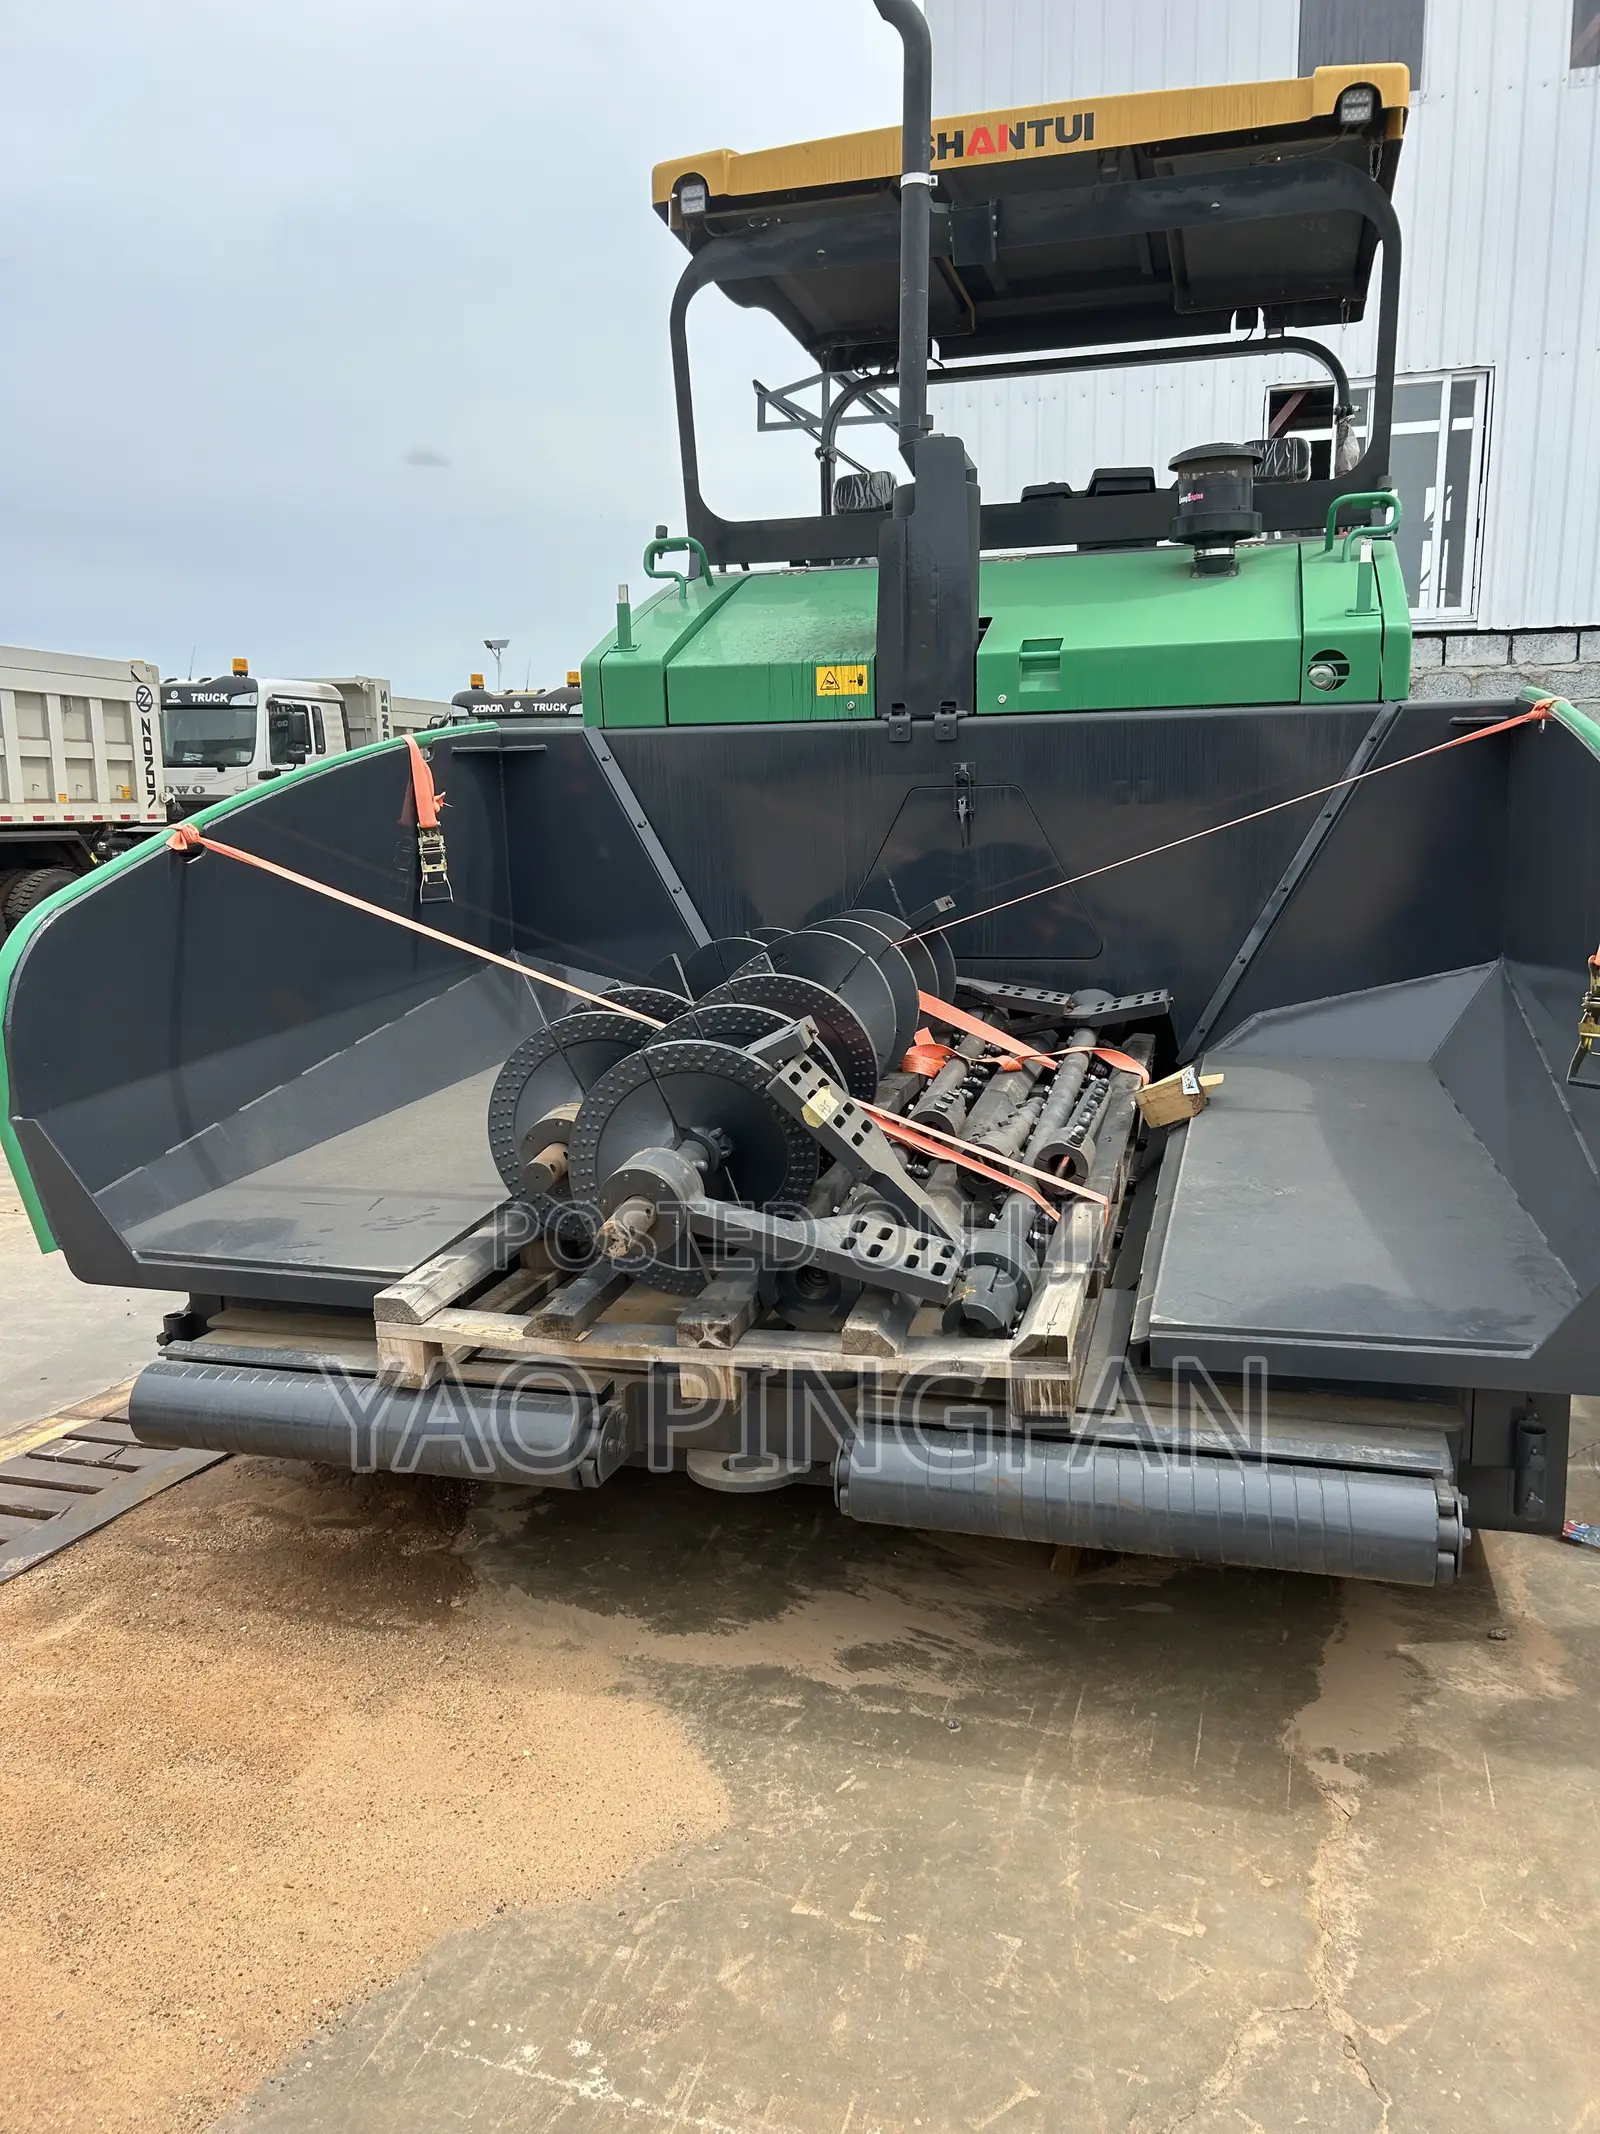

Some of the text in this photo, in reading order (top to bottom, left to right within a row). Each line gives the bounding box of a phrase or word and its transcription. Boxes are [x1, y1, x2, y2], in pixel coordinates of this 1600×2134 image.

[929, 112, 1095, 160] HANTUI
[190, 693, 229, 703] TRUCK
[472, 702, 568, 713] ZONDA TRUCK
[141, 717, 156, 809] ZONDA
